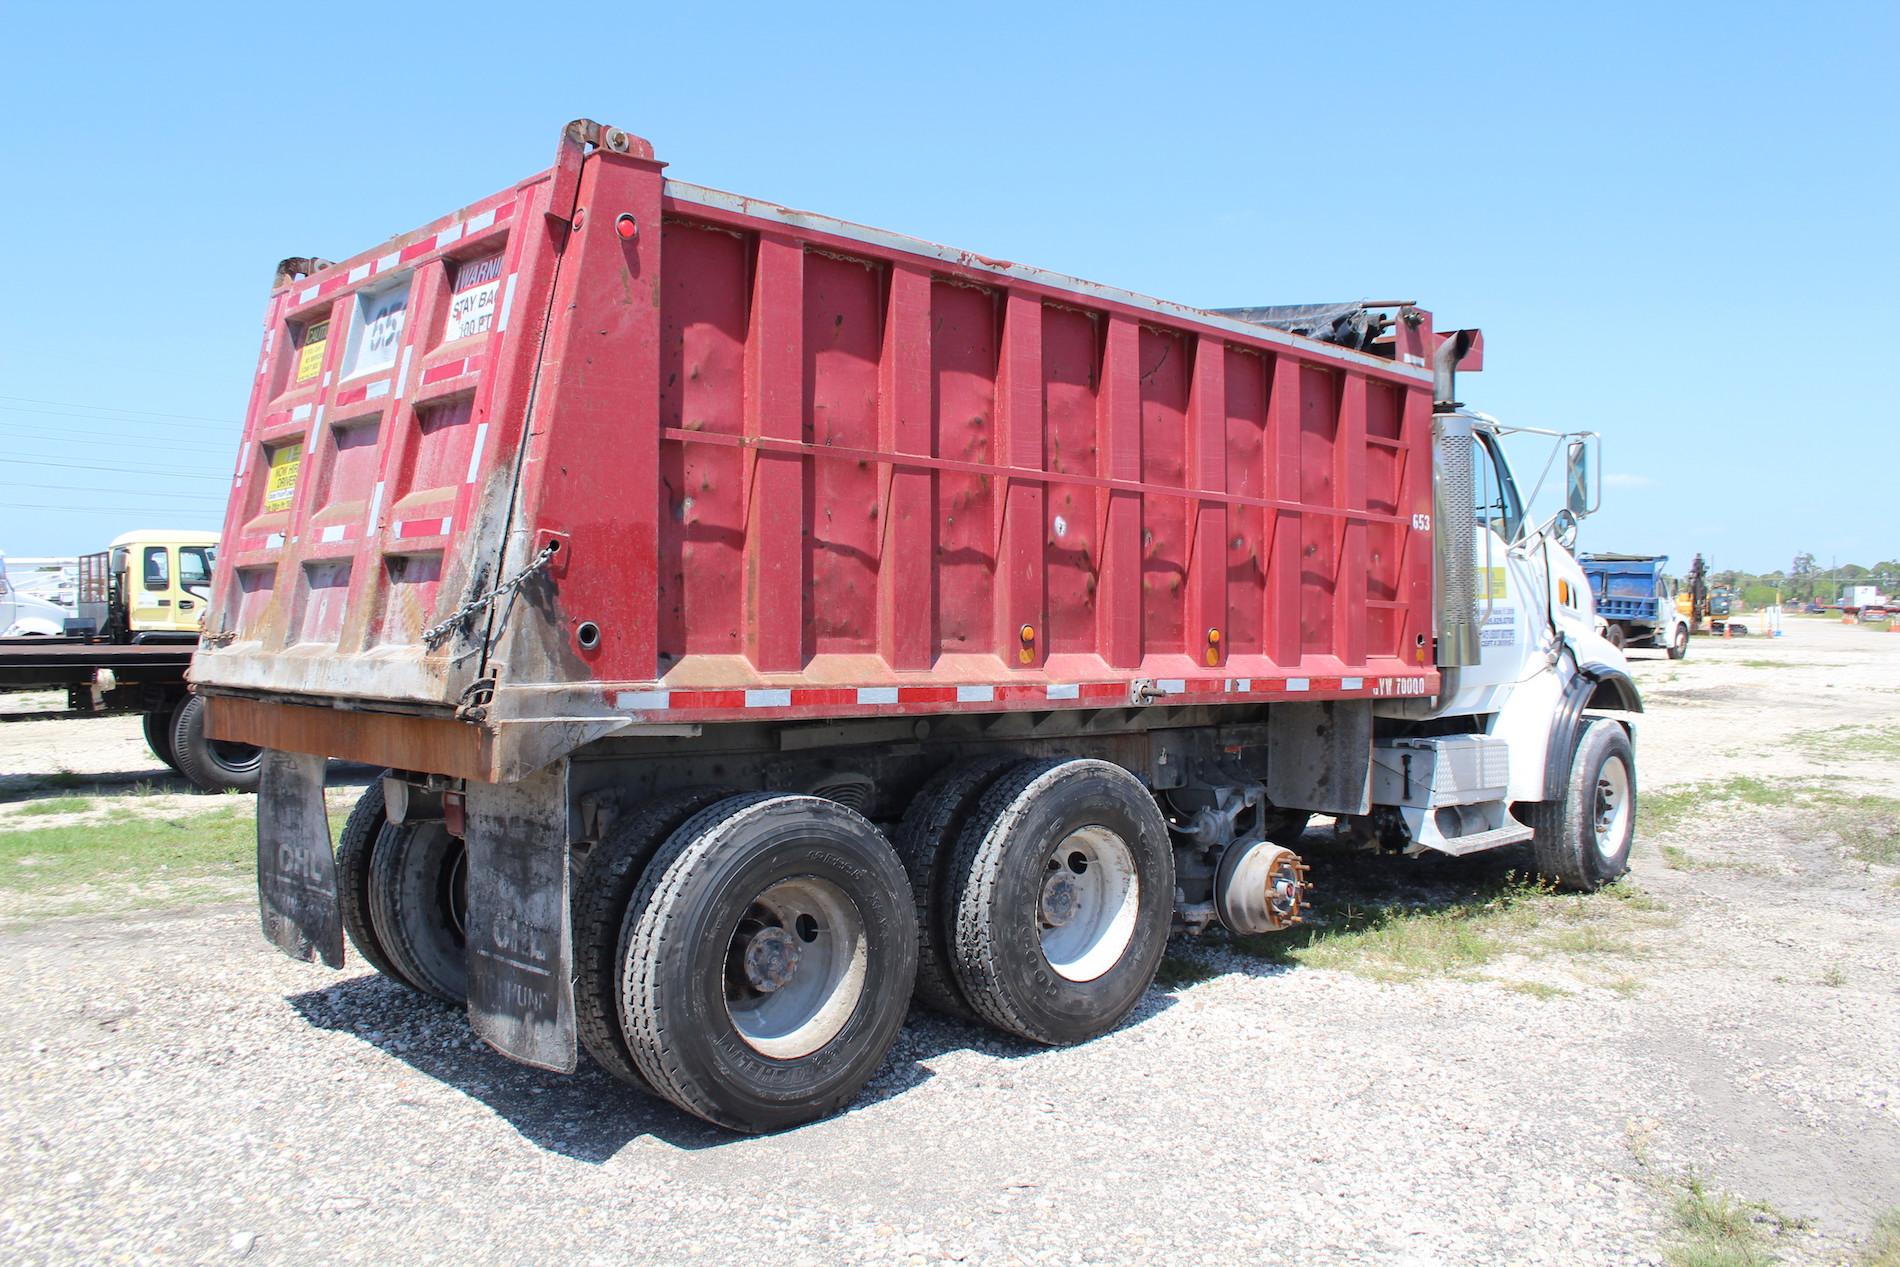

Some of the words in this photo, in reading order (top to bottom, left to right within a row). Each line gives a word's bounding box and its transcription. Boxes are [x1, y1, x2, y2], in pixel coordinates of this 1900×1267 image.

[453, 294, 477, 319] STAY
[1412, 513, 1430, 531] 653
[1395, 677, 1425, 695] 70000
